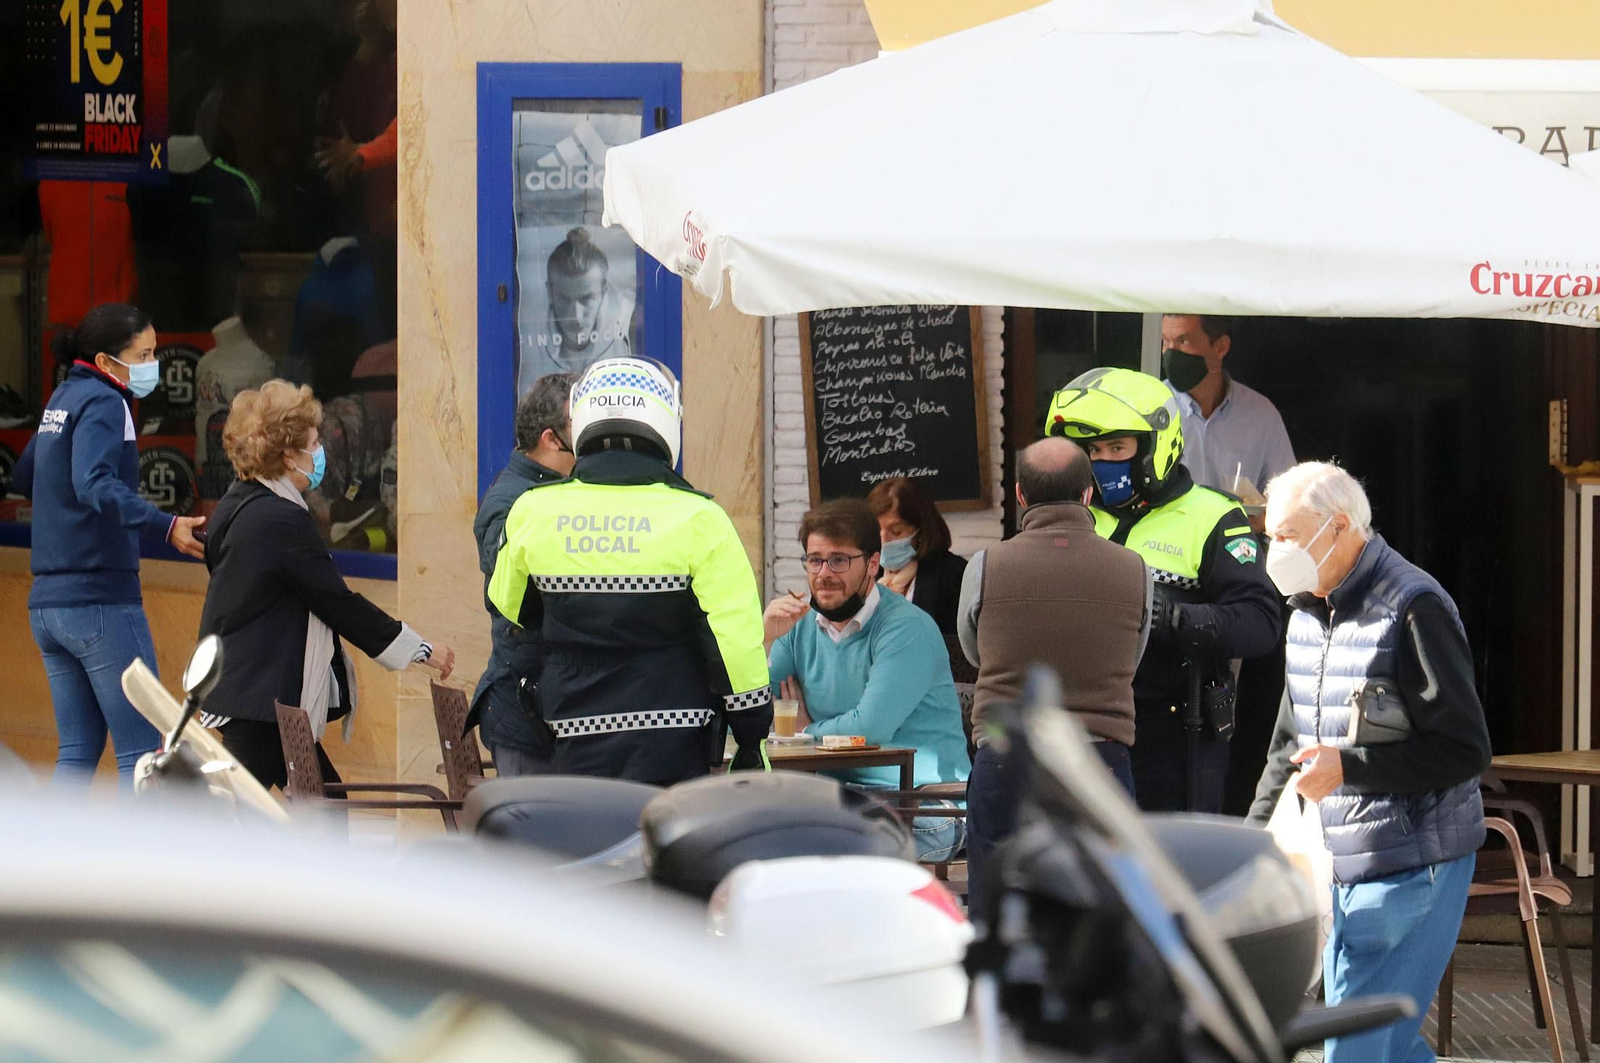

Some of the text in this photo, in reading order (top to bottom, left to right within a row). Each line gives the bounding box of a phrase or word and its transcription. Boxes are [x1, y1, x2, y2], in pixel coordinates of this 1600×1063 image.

[84, 92, 137, 123] BLACK
[84, 124, 142, 154] FRIDAY
[525, 165, 605, 191] adida
[1524, 259, 1570, 268] DESDE
[520, 334, 563, 347] IND
[589, 395, 646, 408] POLICIA
[556, 514, 652, 533] POLICIA
[565, 535, 641, 554] LOCAL
[1141, 539, 1184, 558] POLICIA
